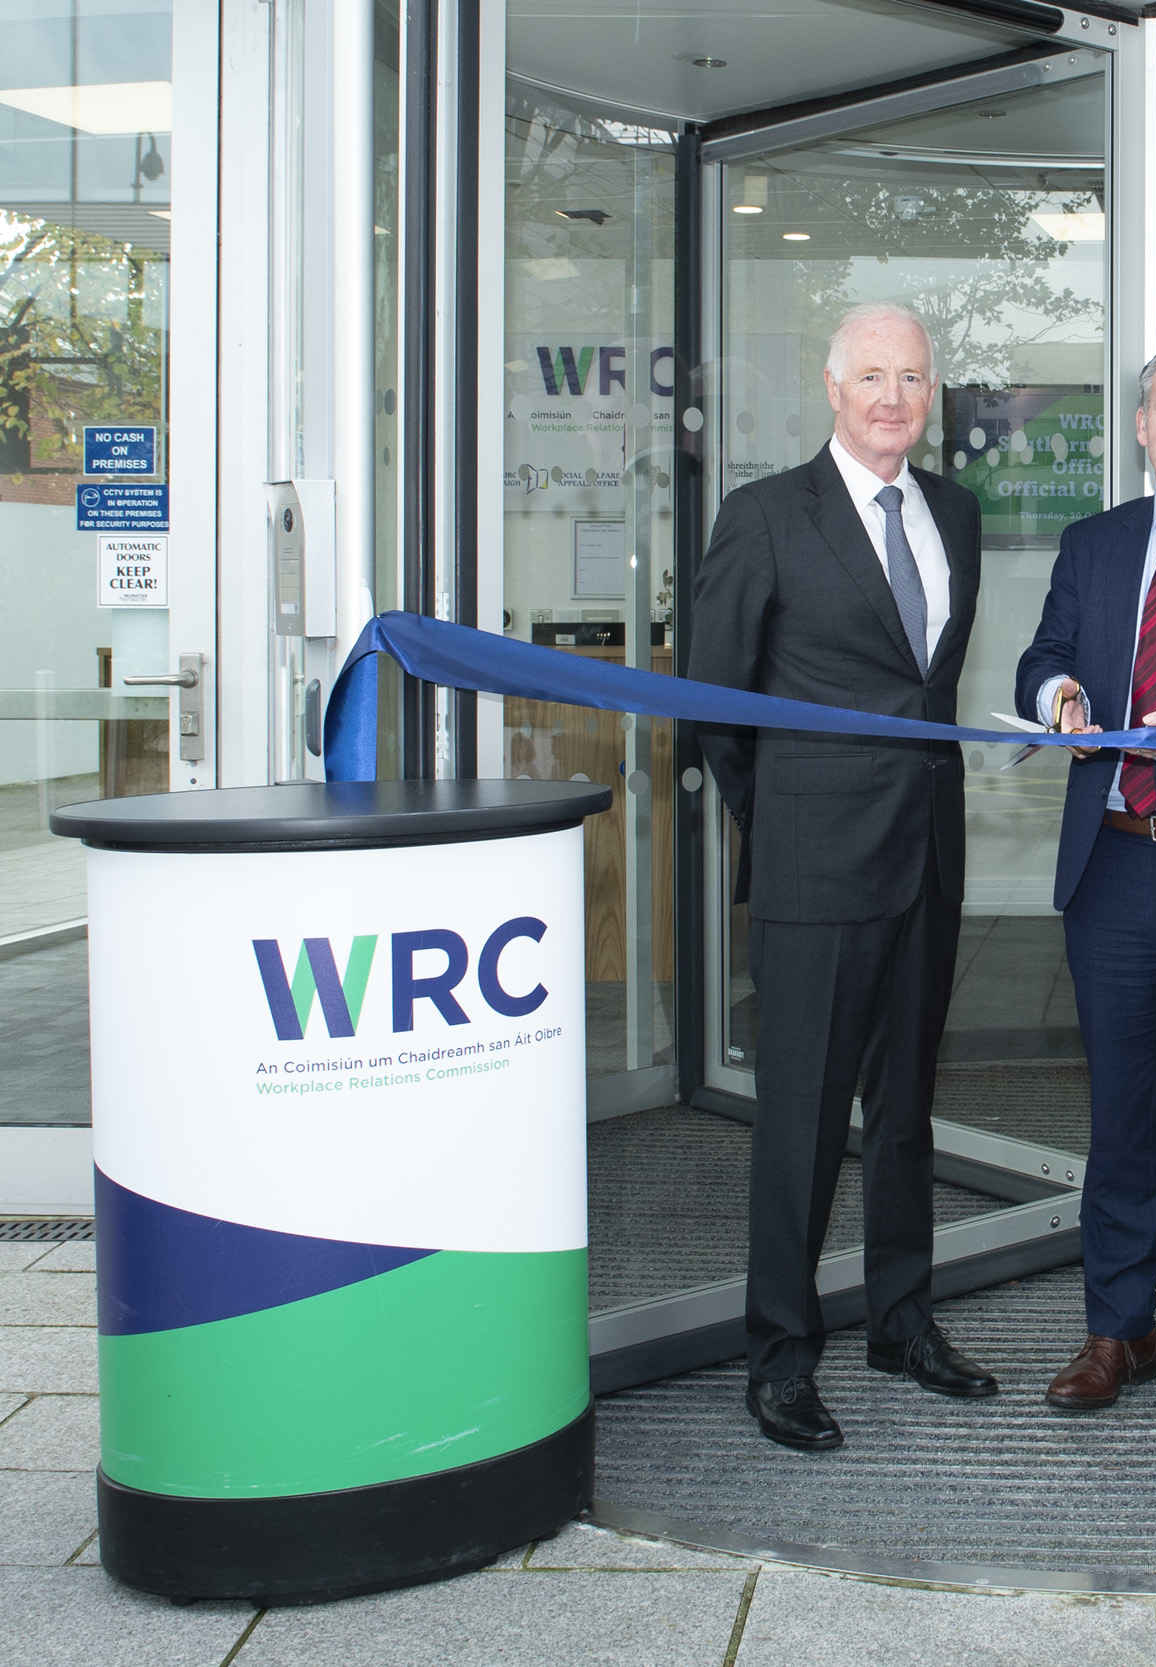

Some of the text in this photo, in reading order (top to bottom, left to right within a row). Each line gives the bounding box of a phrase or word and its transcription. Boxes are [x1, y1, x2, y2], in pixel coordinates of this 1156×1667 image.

[536, 346, 674, 397] WRC
[530, 408, 571, 420] oimisiún
[592, 410, 624, 420] Chaidr
[586, 423, 624, 433] Relatio
[95, 433, 144, 442] NO CASH
[111, 446, 128, 456] ON
[92, 459, 147, 469] PREMISES
[1052, 458, 1104, 474] Offic
[595, 472, 620, 480] LFARE
[103, 488, 163, 497] CCTV SYSTEM IS
[998, 479, 1076, 497] Official
[107, 499, 158, 507] IN OPERATION
[87, 510, 162, 518] ON THESE PREMISES
[80, 520, 95, 528] FOR
[96, 520, 130, 528] SECURITY
[106, 542, 161, 551] AUTOMATIC
[116, 553, 151, 561] DOORS
[116, 566, 151, 577] KEEP
[109, 578, 158, 589] CLEAR!
[252, 916, 549, 1040] WRC
[256, 1025, 562, 1074] An Coimisiún um Chaidreamh san Áit Oibre
[256, 1057, 510, 1096] Workplace Relations Commission
